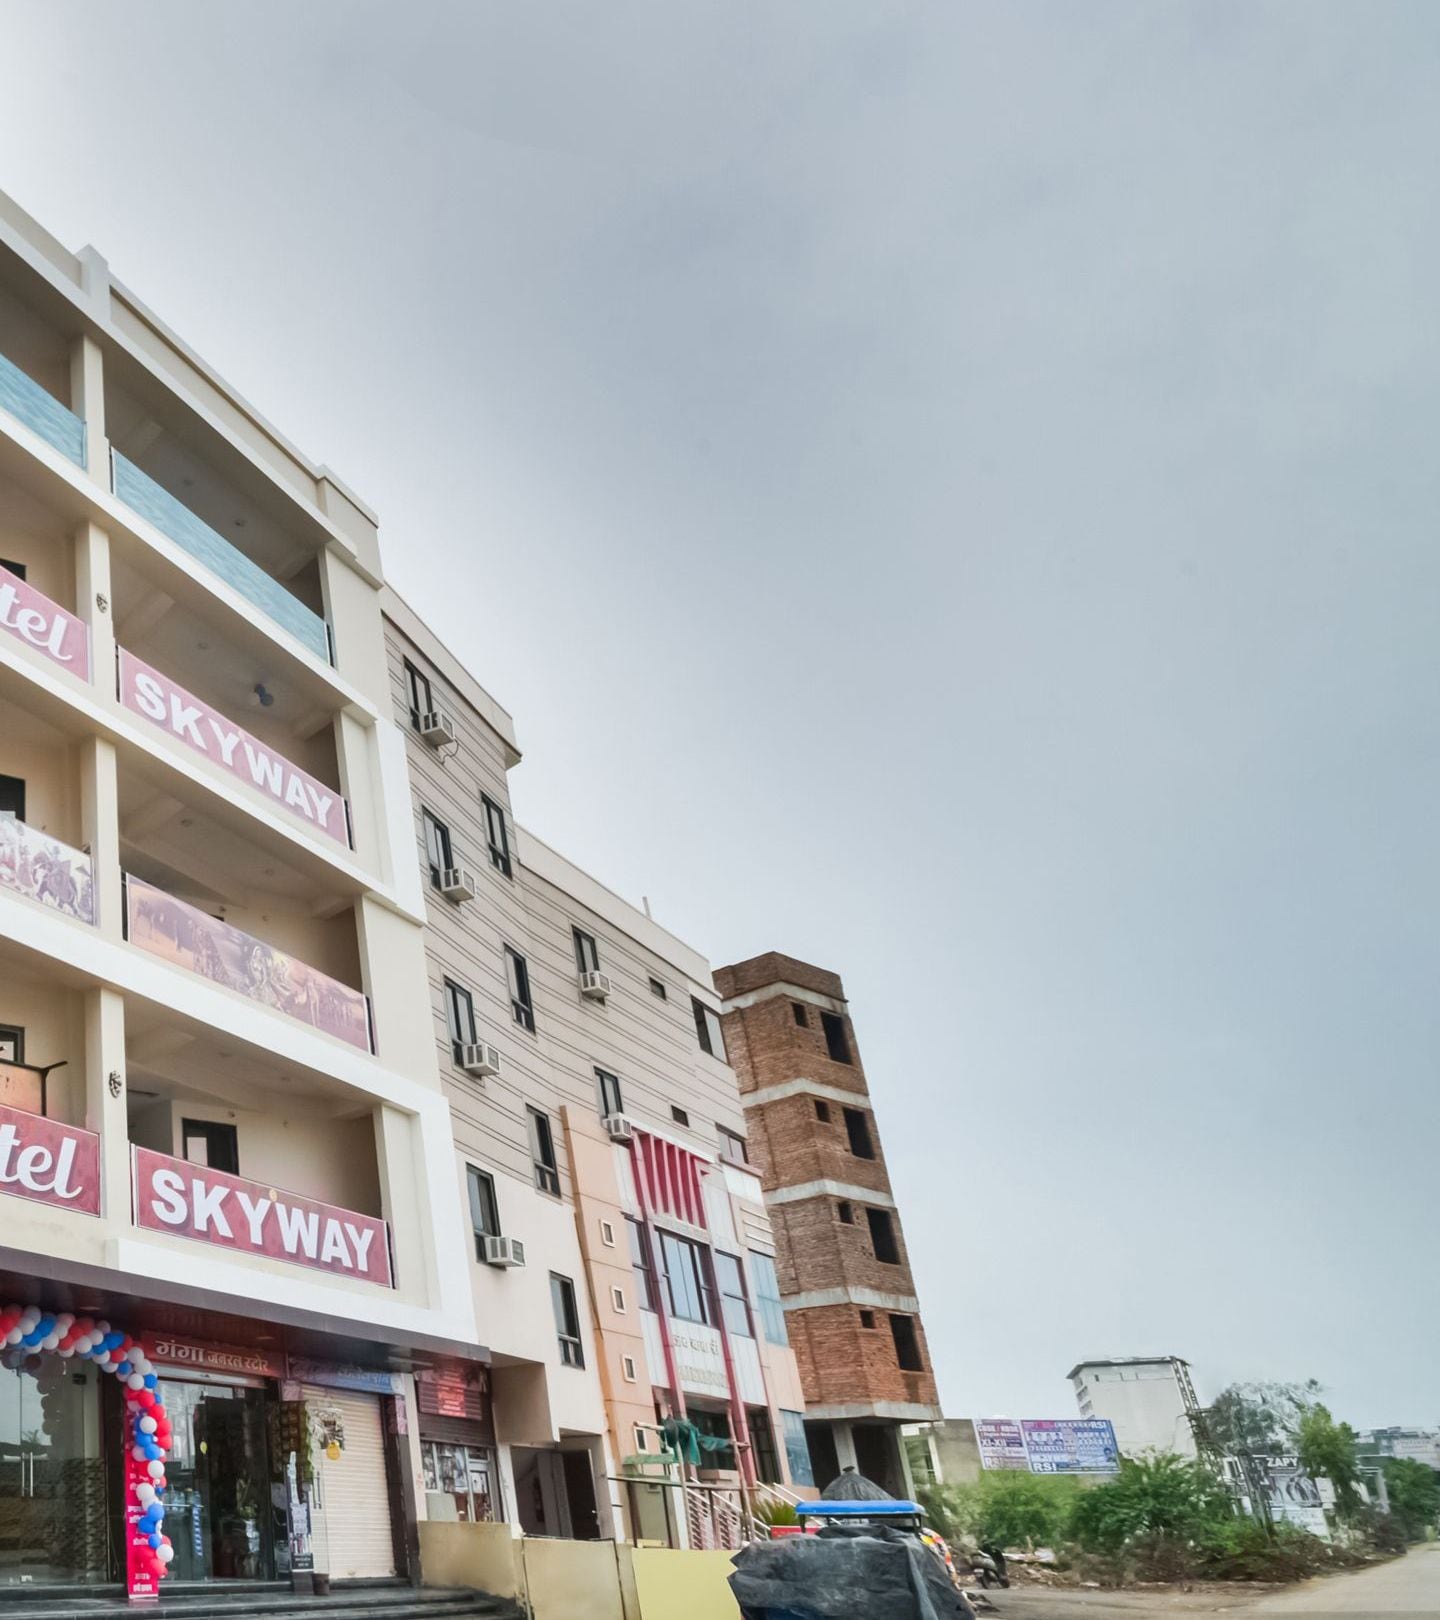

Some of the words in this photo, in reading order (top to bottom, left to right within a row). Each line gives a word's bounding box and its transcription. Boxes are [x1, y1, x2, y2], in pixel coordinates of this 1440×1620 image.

[135, 672, 333, 828] SKYWAY
[151, 1169, 374, 1272] SKYWAY
[155, 1340, 206, 1362] गंगा
[1033, 1462, 1057, 1472] RSI
